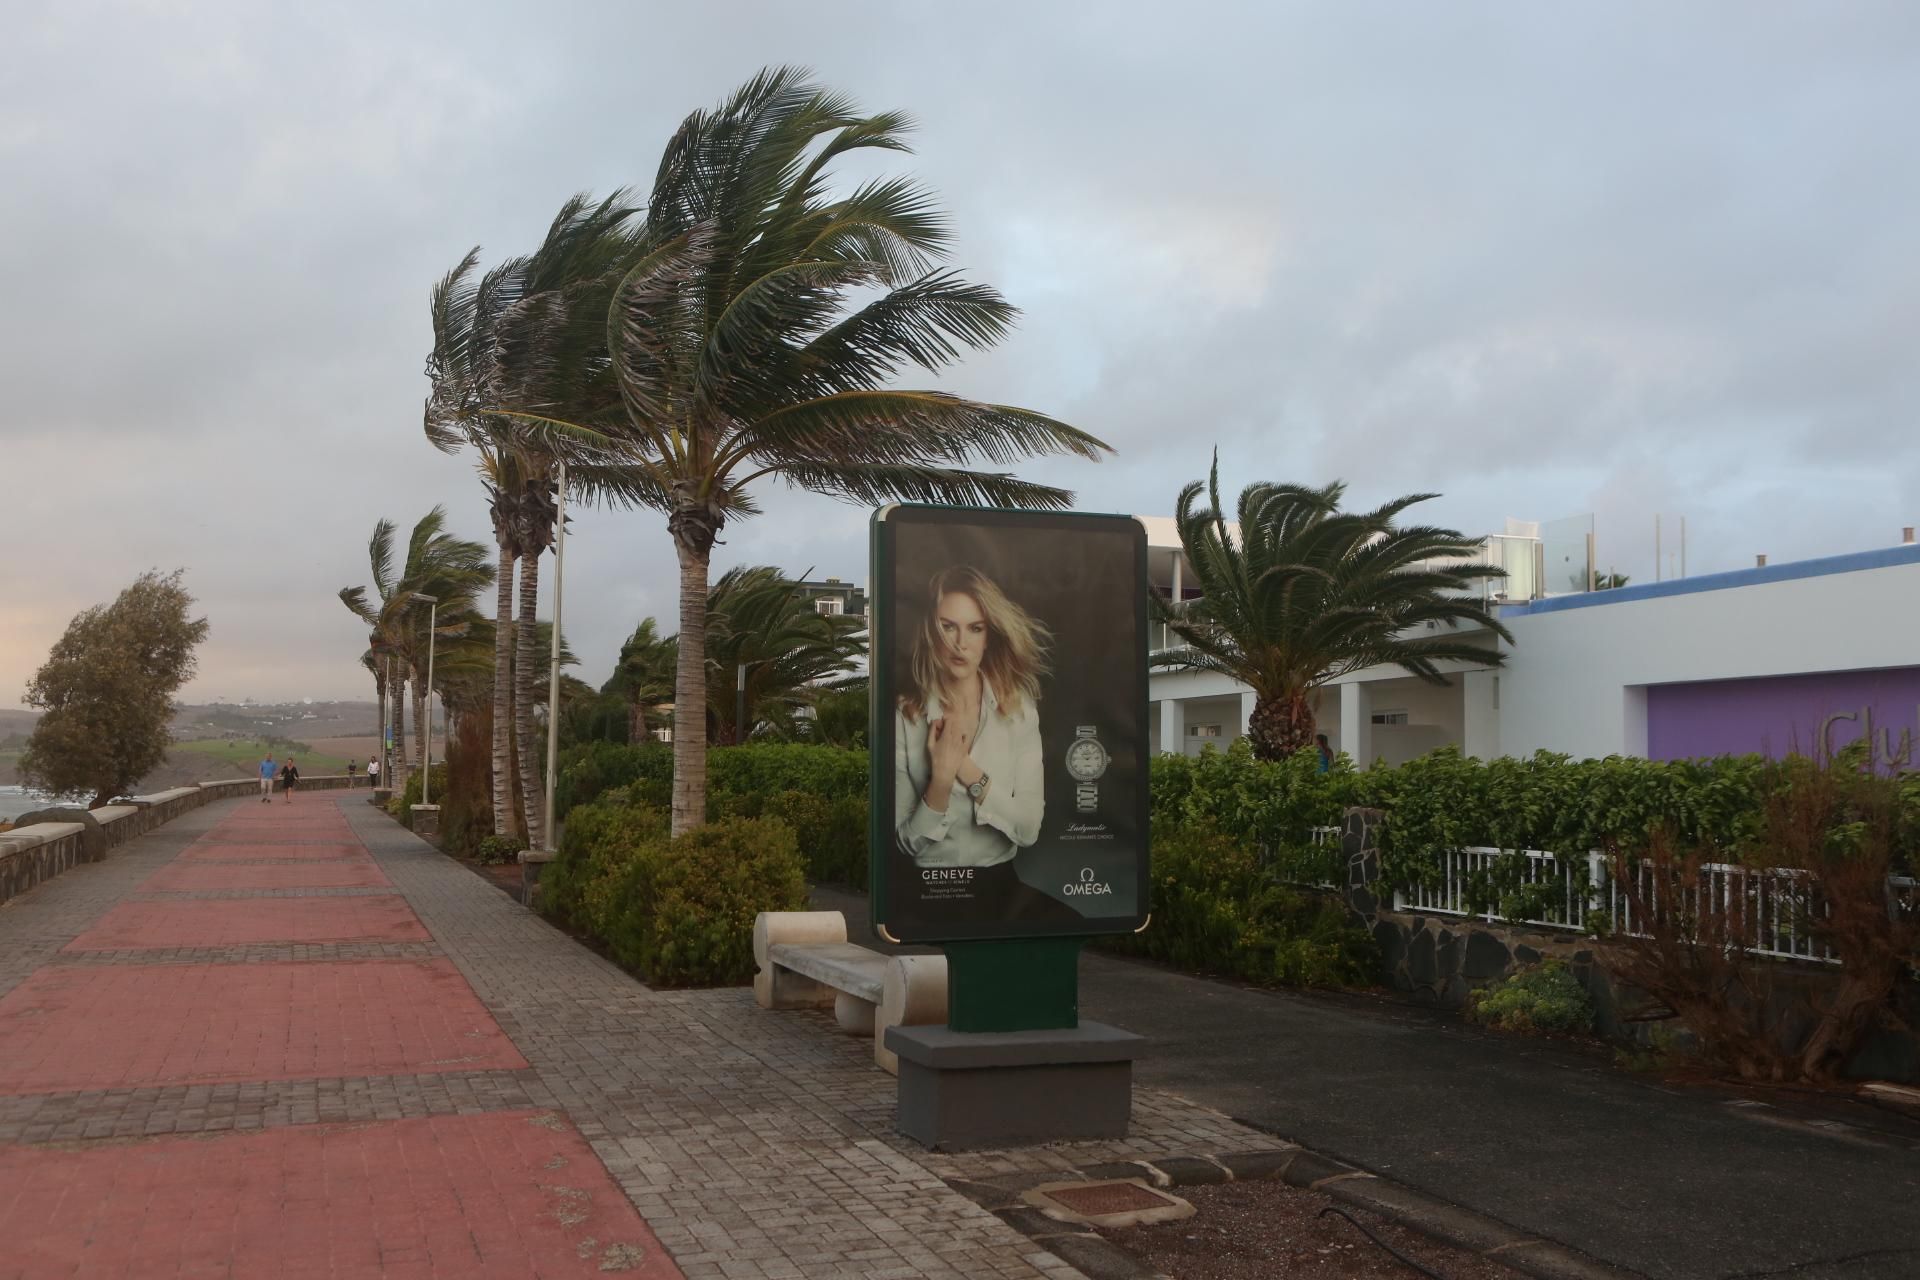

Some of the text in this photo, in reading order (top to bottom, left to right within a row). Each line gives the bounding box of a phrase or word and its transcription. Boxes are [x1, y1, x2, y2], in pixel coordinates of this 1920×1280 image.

[1819, 703, 1920, 766] Clu
[922, 869, 974, 879] GENEVE
[1063, 882, 1112, 896] OMEGA
